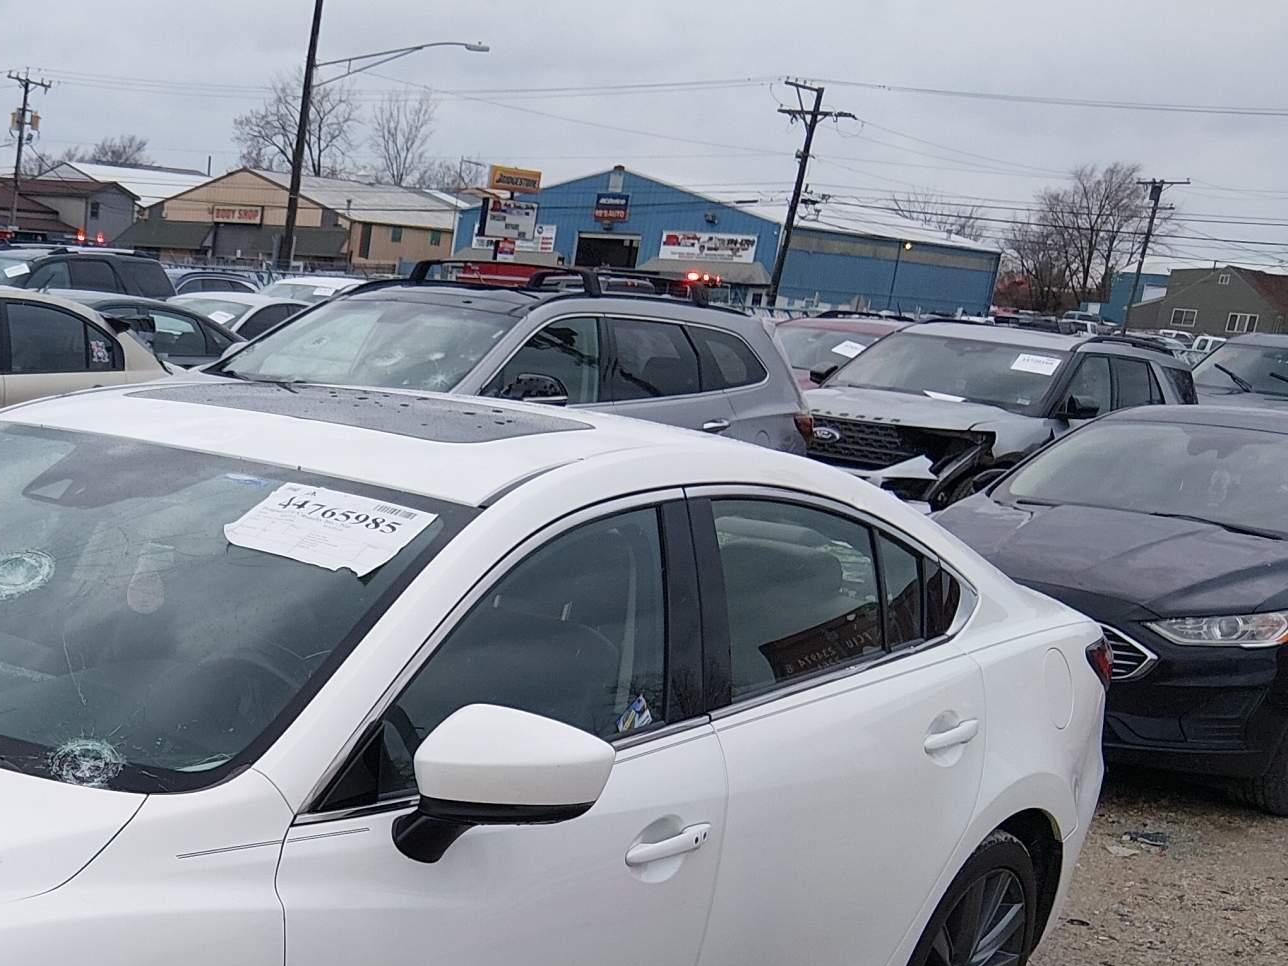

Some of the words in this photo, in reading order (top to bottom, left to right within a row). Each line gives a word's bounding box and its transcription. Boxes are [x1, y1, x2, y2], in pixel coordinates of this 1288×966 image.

[215, 208, 236, 219] BODY
[237, 209, 259, 221] SHOP
[277, 496, 402, 534] 44765985
